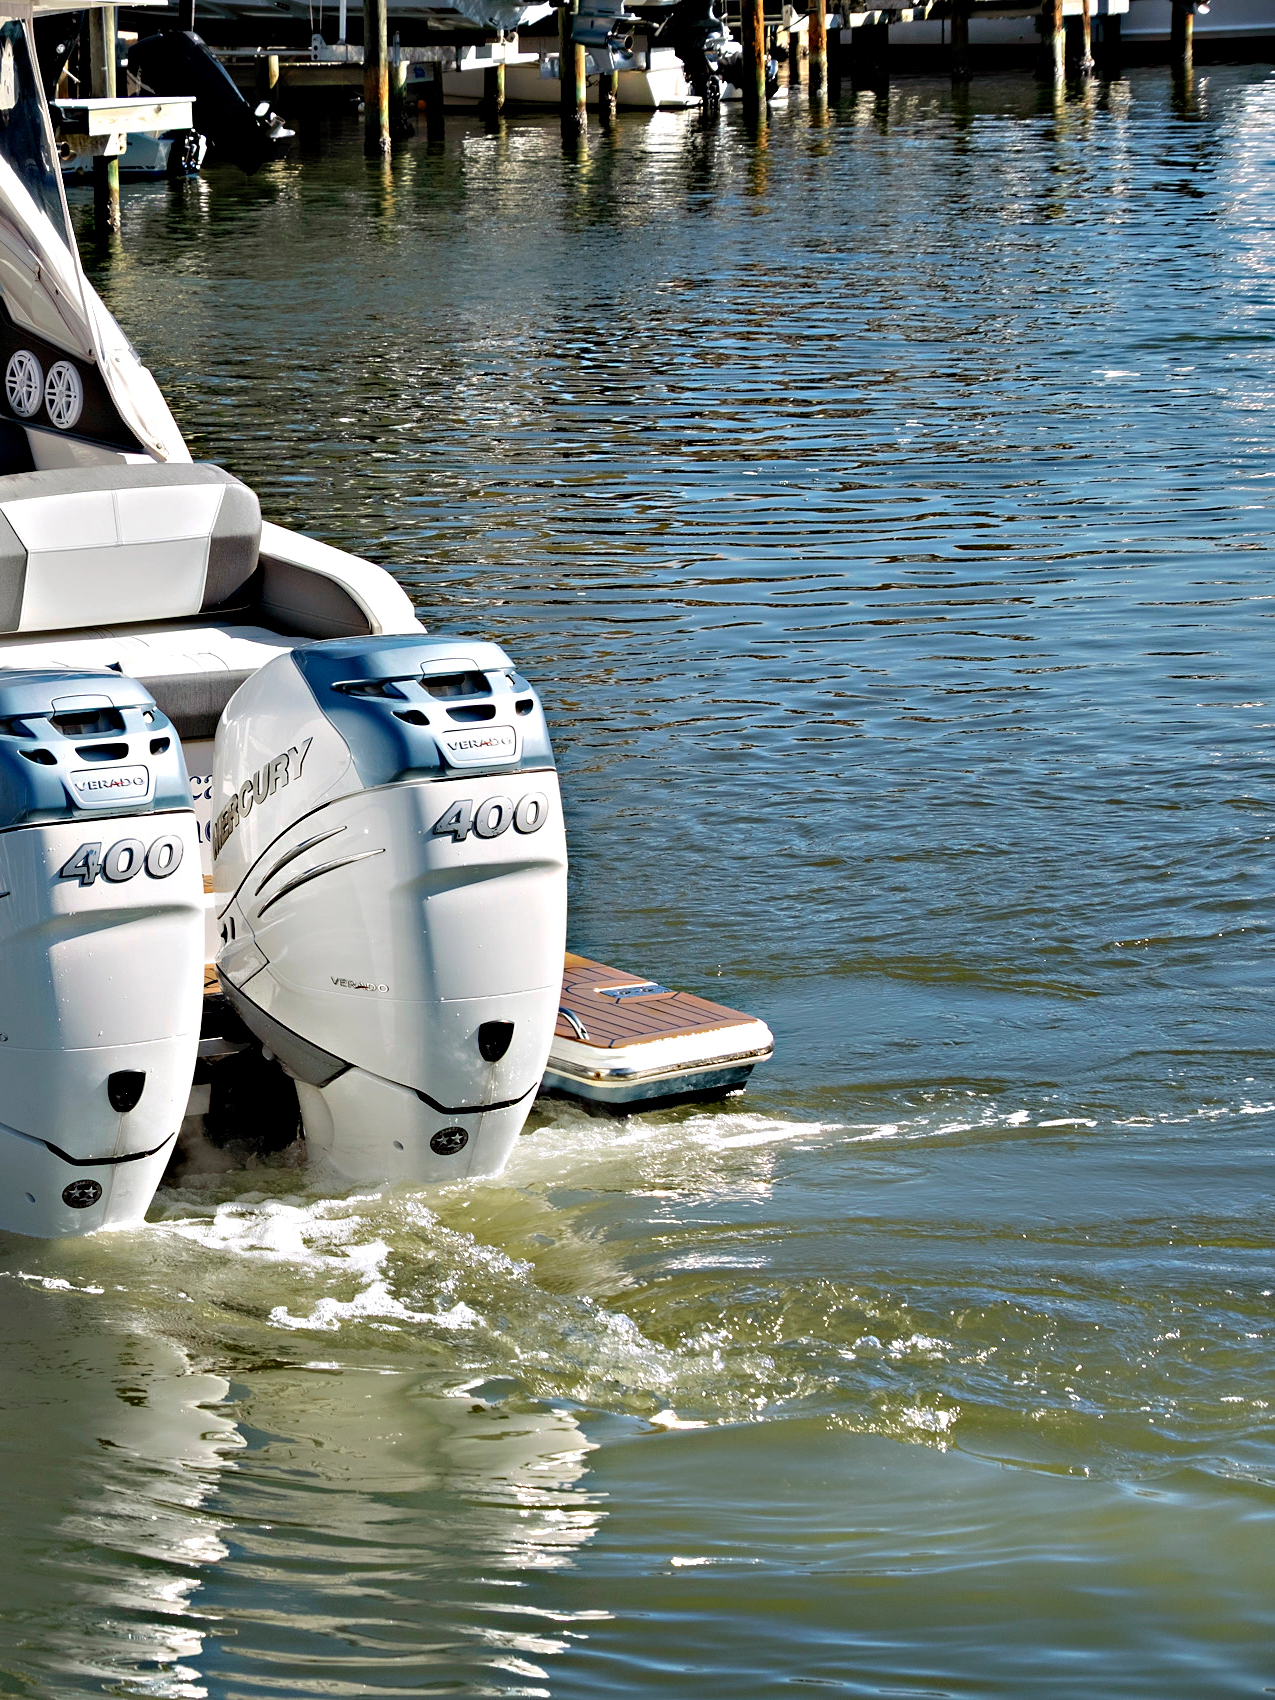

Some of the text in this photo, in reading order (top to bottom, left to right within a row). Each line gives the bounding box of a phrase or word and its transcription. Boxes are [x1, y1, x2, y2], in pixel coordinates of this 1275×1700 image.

[446, 737, 512, 751] VERADO
[74, 777, 145, 792] VERADO
[433, 791, 550, 842] 400
[59, 834, 184, 887] 400
[330, 976, 390, 993] VERADO
